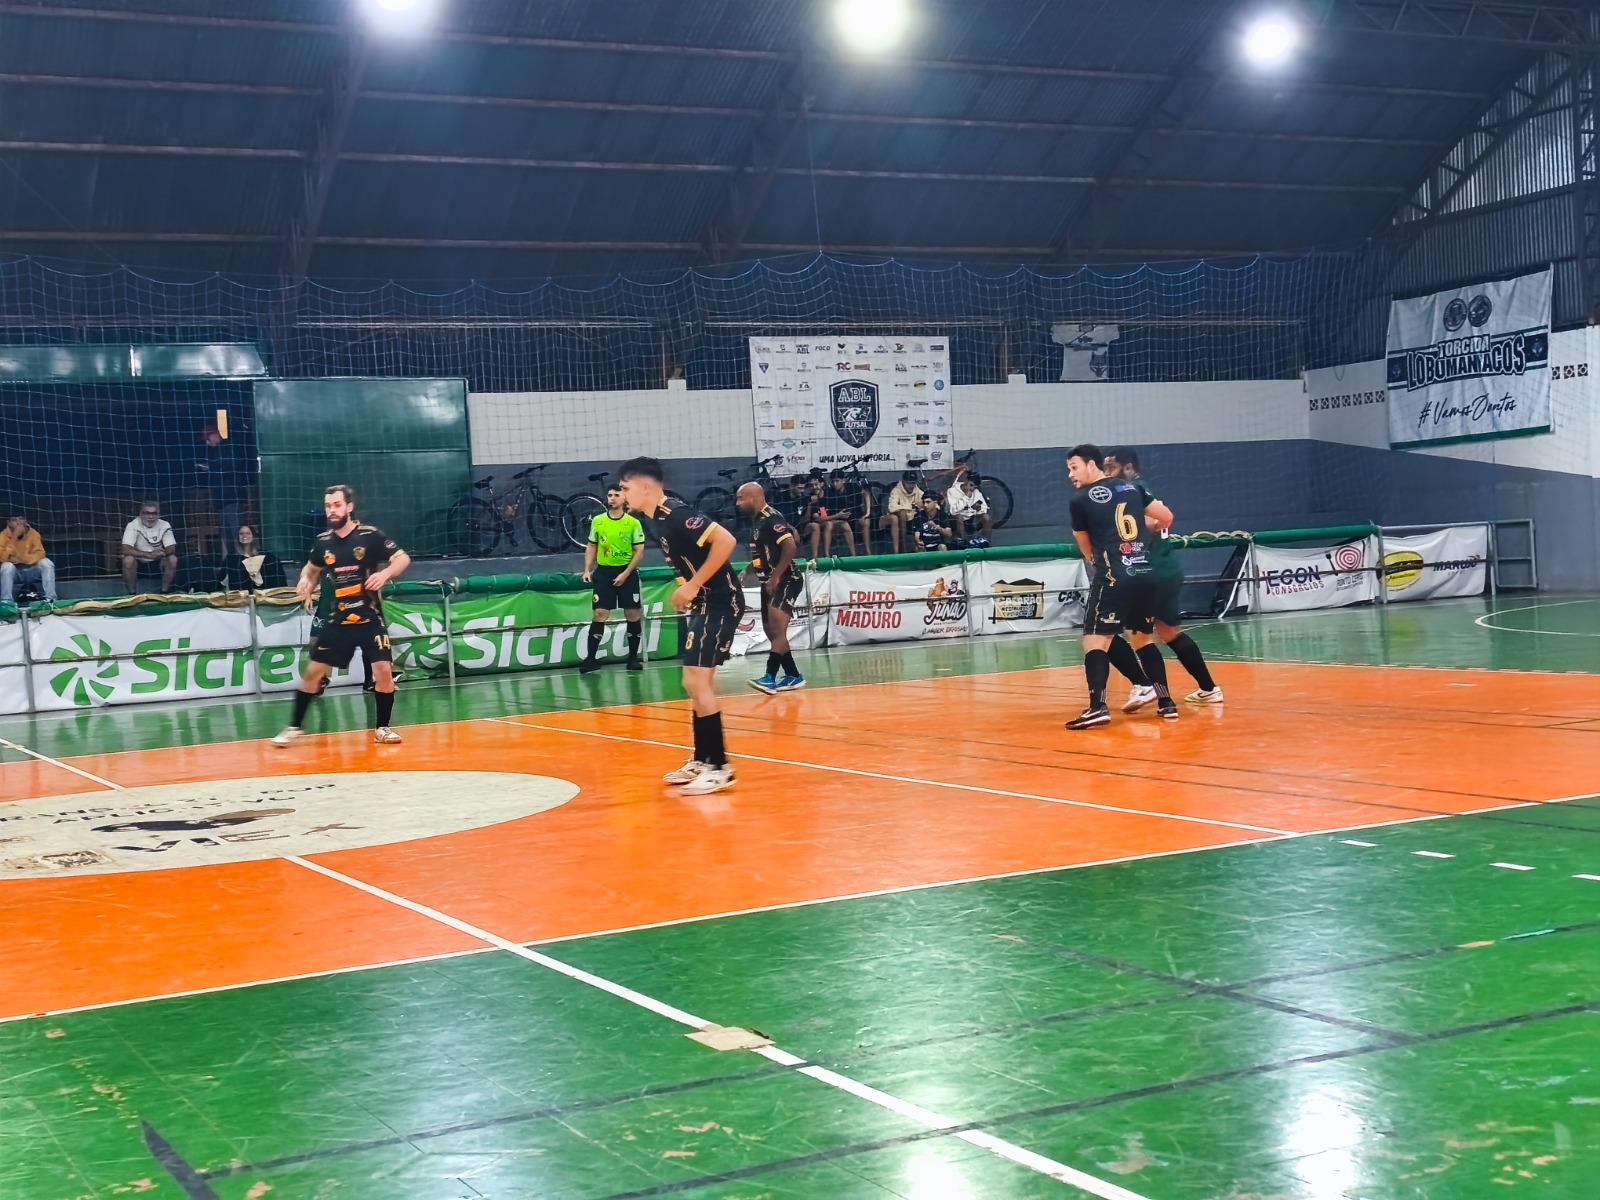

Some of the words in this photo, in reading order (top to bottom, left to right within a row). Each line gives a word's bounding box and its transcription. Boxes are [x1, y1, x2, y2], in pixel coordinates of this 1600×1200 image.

[1438, 334, 1490, 358] TORCIDA
[838, 387, 871, 402] ABL
[819, 455, 834, 463] UMA
[836, 454, 856, 462] NOVA
[1115, 501, 1138, 541] 6
[848, 591, 896, 610] FRUTO
[836, 609, 902, 630] MADURO
[374, 634, 391, 650] 14
[459, 601, 663, 670] Sicredi
[685, 631, 695, 650] 8
[130, 636, 349, 695] Sicre
